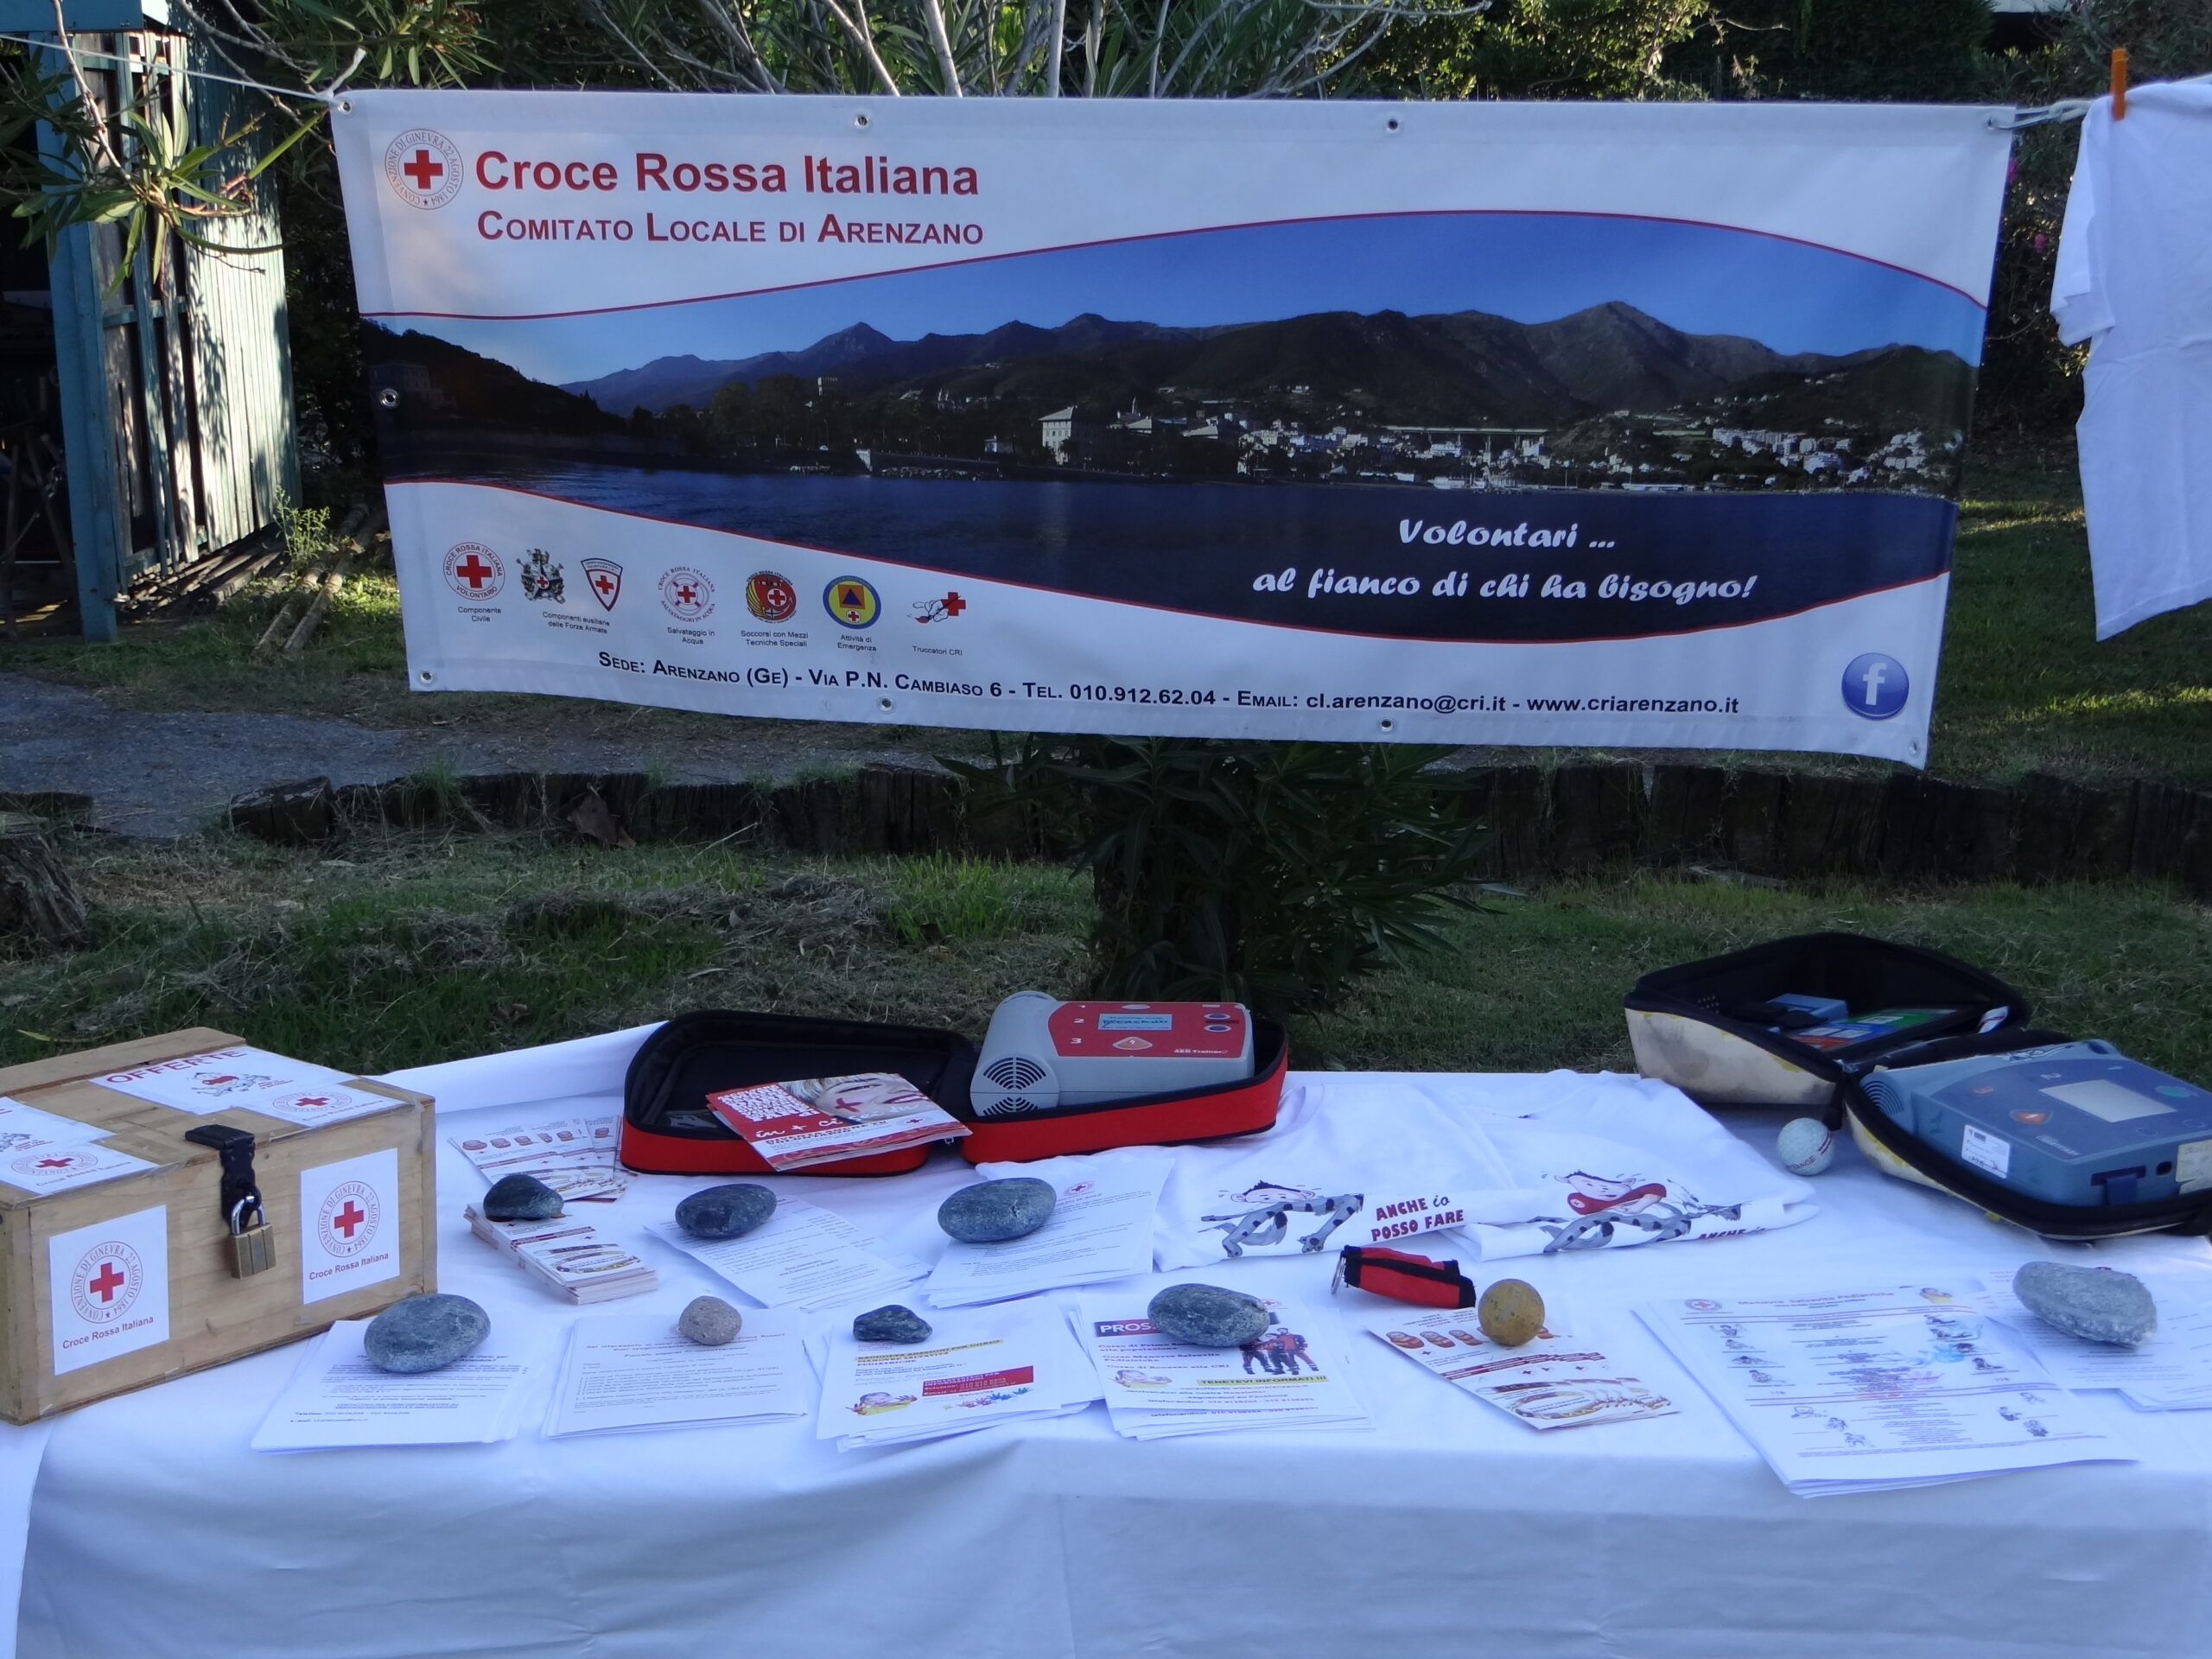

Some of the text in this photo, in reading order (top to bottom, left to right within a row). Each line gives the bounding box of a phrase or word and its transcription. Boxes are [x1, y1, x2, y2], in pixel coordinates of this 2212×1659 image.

[388, 131, 461, 207] CONVENZIONE DI GINEVRA 22 AGOSTO 1864
[476, 150, 978, 195] Croce Rossa Italiana
[1399, 518, 1578, 548] Volontari
[446, 543, 503, 577] CROCE ROSSA ITALIANA
[658, 572, 671, 591] CROCE
[692, 568, 716, 593] ITALIANA
[1252, 568, 1758, 606] al fianco di chi ha bisogno!
[455, 584, 499, 599] VOLONTARIO
[458, 607, 502, 615] Componente
[472, 614, 491, 623] Civile
[543, 611, 582, 623] Componenti
[661, 600, 696, 623] SALVATAGGIO
[702, 602, 716, 620] ACQUA
[564, 621, 584, 632] Forze
[584, 625, 608, 634] Armate
[667, 626, 708, 638] Salvataggio
[741, 630, 772, 639] Soccorsi
[682, 637, 704, 645] Acqua
[779, 639, 808, 648] Speciali
[840, 634, 864, 643] Attività
[837, 642, 877, 652] Emergenza
[912, 645, 948, 655] Truccatori
[846, 671, 889, 690] P.N.
[989, 682, 1002, 697] 6
[1069, 683, 1216, 706] 010.912.62.04
[1306, 692, 1506, 715] cl.arenzano@cri.it
[1526, 696, 1739, 715] www.criarenzano.it
[106, 1050, 248, 1083] OFFERTE
[1376, 1194, 1451, 1222] ANCHE io
[1370, 1209, 1465, 1242] POSSO FARE
[90, 1244, 125, 1262] GINEVRA
[125, 1252, 137, 1263] 22
[79, 1259, 92, 1272] DI
[308, 1252, 389, 1281] Croce Rossa Italiana
[73, 1272, 104, 1321] CONVENZIONE
[62, 1316, 154, 1349] Croce Rossa Italiana
[1254, 1376, 1316, 1384] INFORMATI
